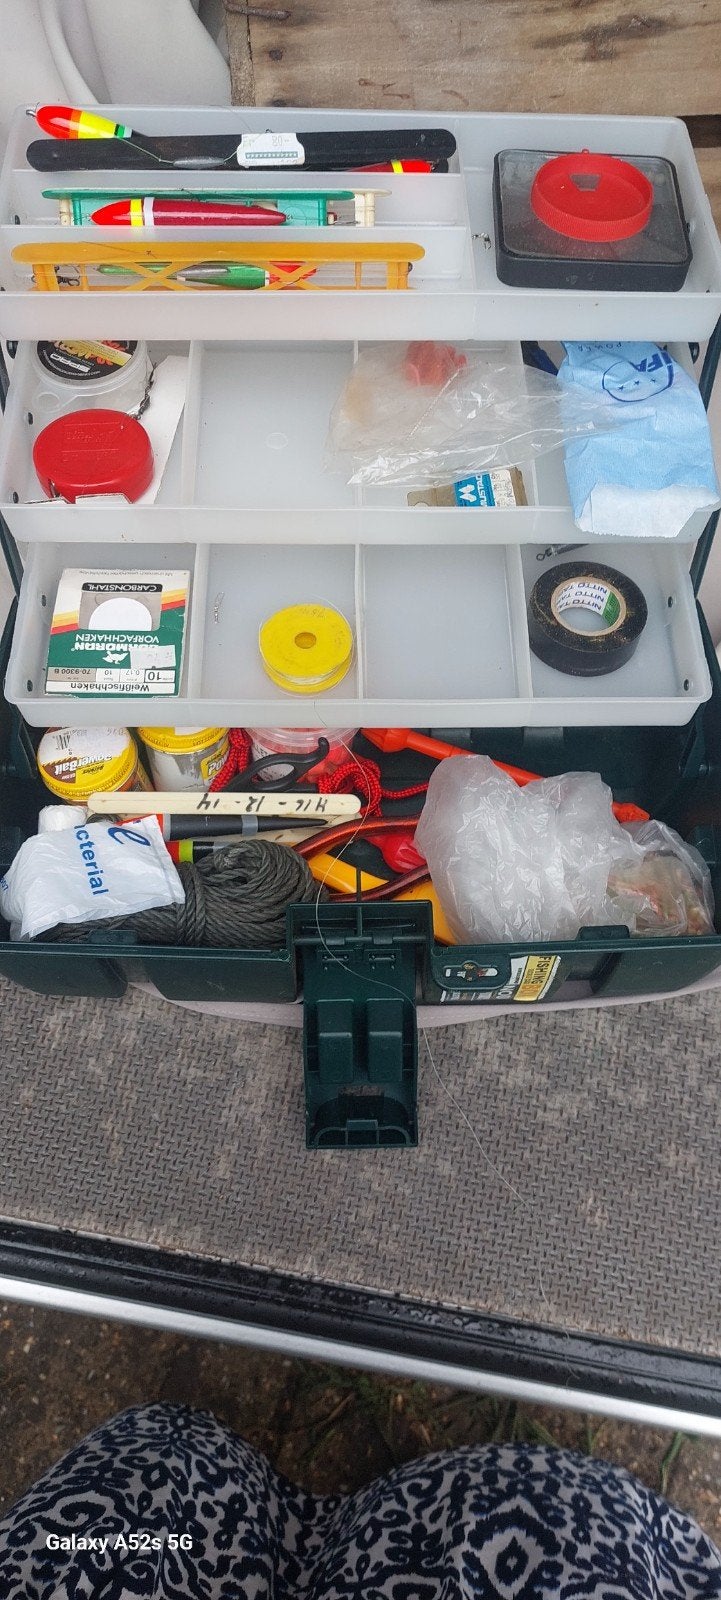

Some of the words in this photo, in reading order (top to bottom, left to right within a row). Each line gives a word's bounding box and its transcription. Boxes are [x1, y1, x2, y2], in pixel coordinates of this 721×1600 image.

[88, 583, 158, 592] CARBONSTAHL
[578, 582, 608, 594] NITTO
[575, 591, 605, 603] NITTO
[572, 599, 602, 610] NITTO
[75, 633, 159, 643] VORFACHHAKEN
[148, 671, 162, 680] 10
[70, 682, 150, 692] Weißfischhaken
[531, 956, 551, 984] FISHING
